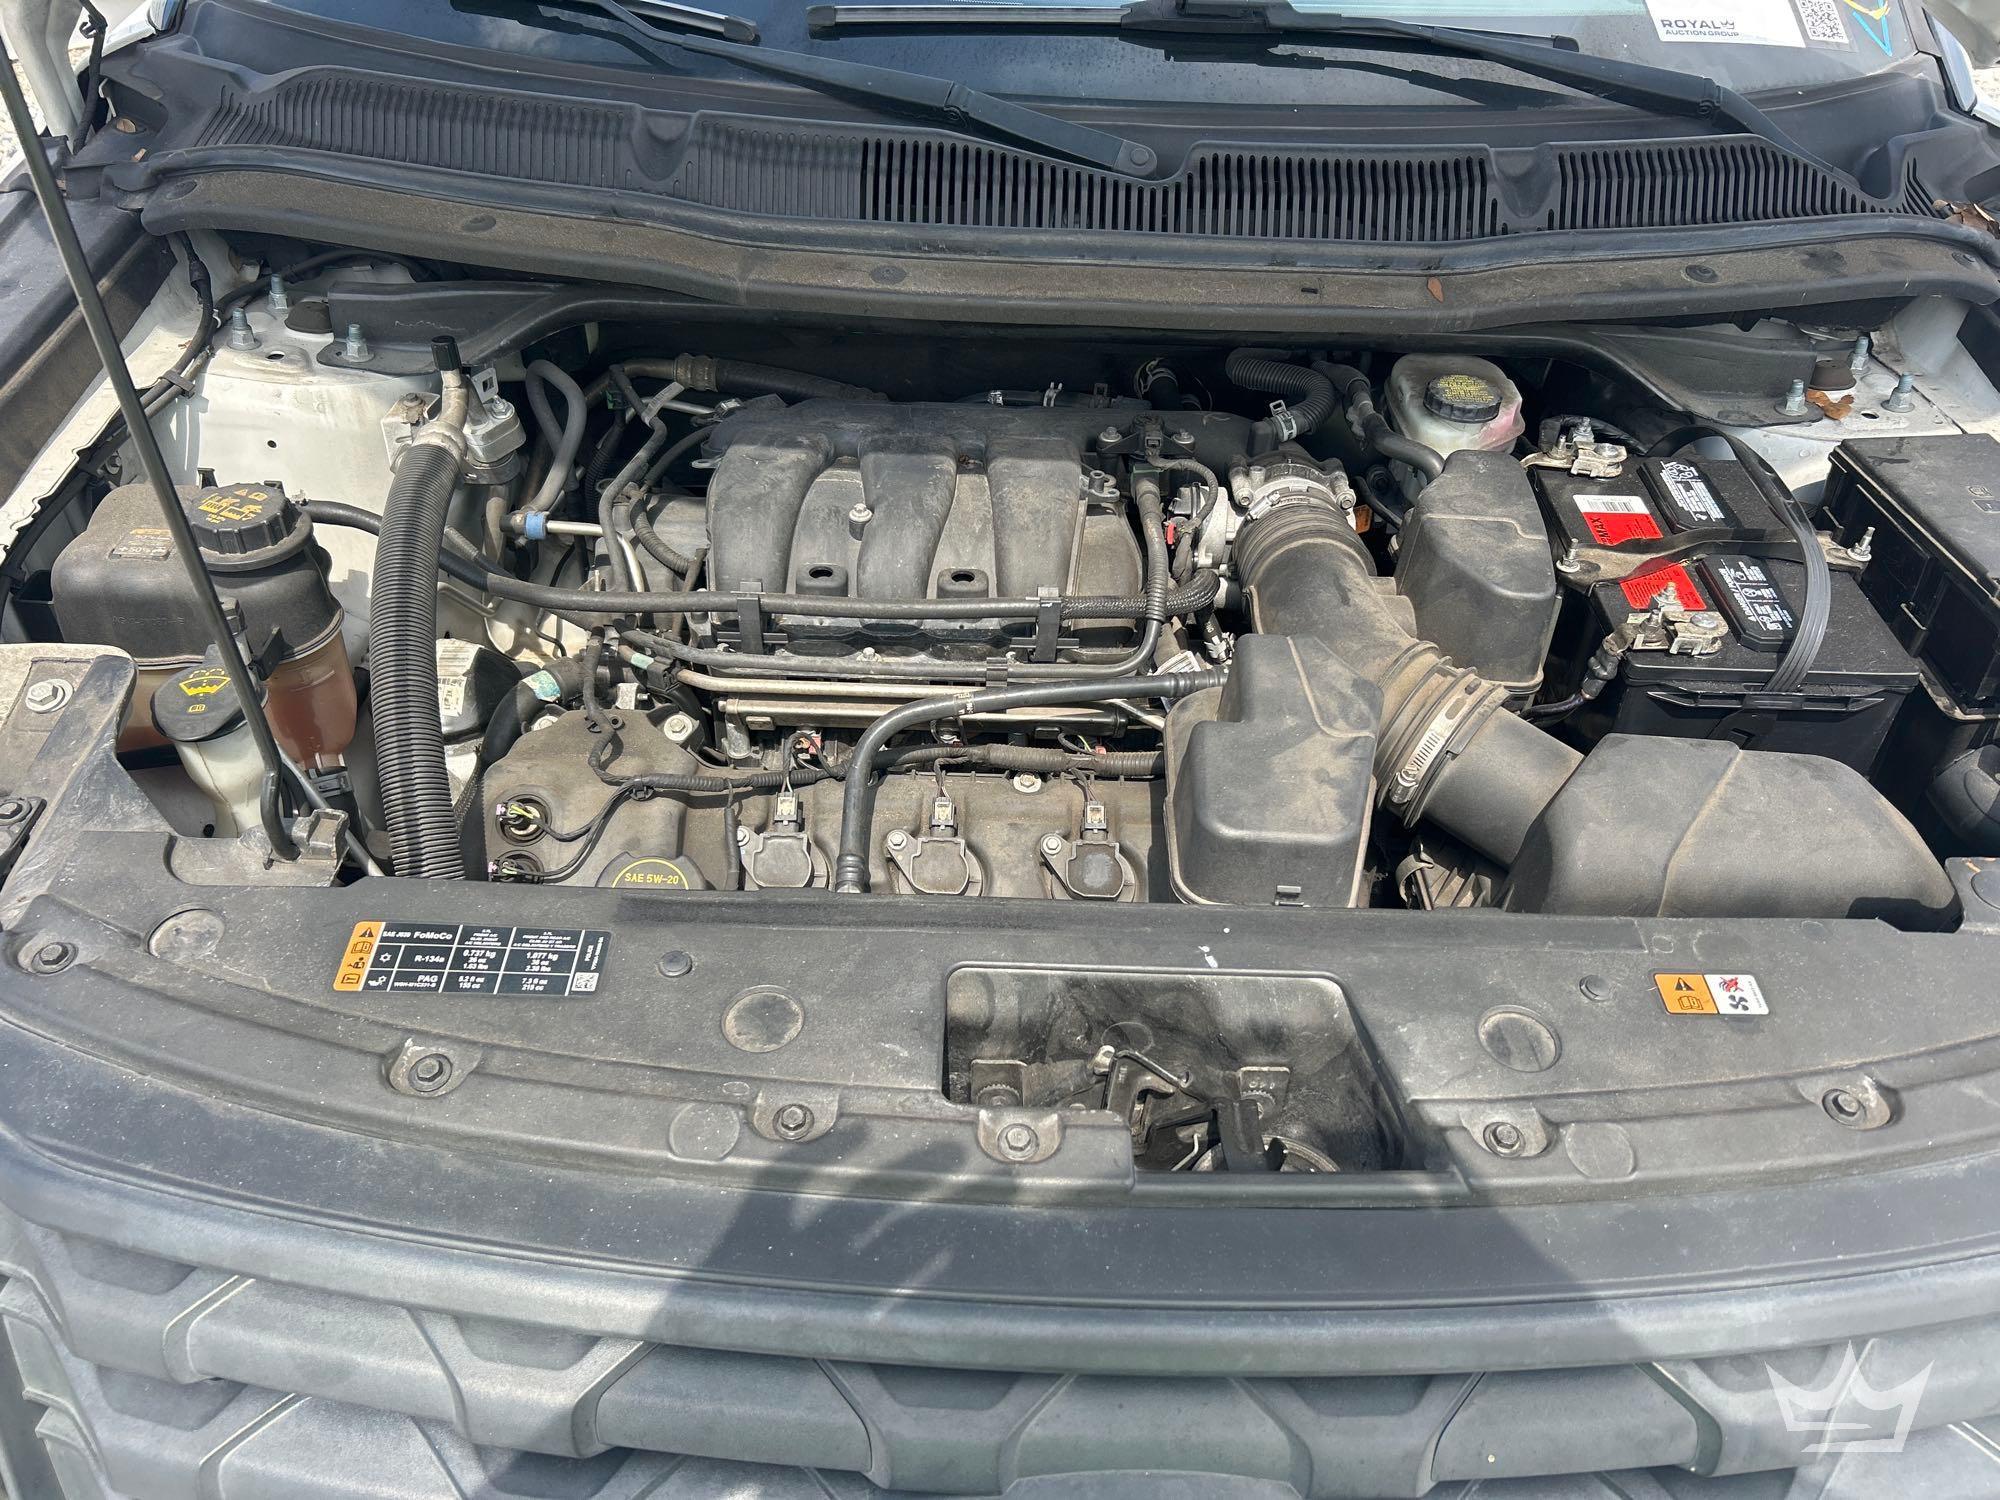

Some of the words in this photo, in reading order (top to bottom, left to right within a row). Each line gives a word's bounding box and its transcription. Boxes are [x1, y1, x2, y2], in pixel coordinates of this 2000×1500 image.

[1660, 19, 1721, 29] ROYAL
[624, 872, 644, 883] SAE
[646, 873, 679, 885] 5W-20
[413, 931, 453, 940] FoMoCo
[414, 954, 445, 963] R-134a
[485, 950, 497, 959] kg
[548, 952, 559, 961] kg
[417, 974, 439, 983] PAG
